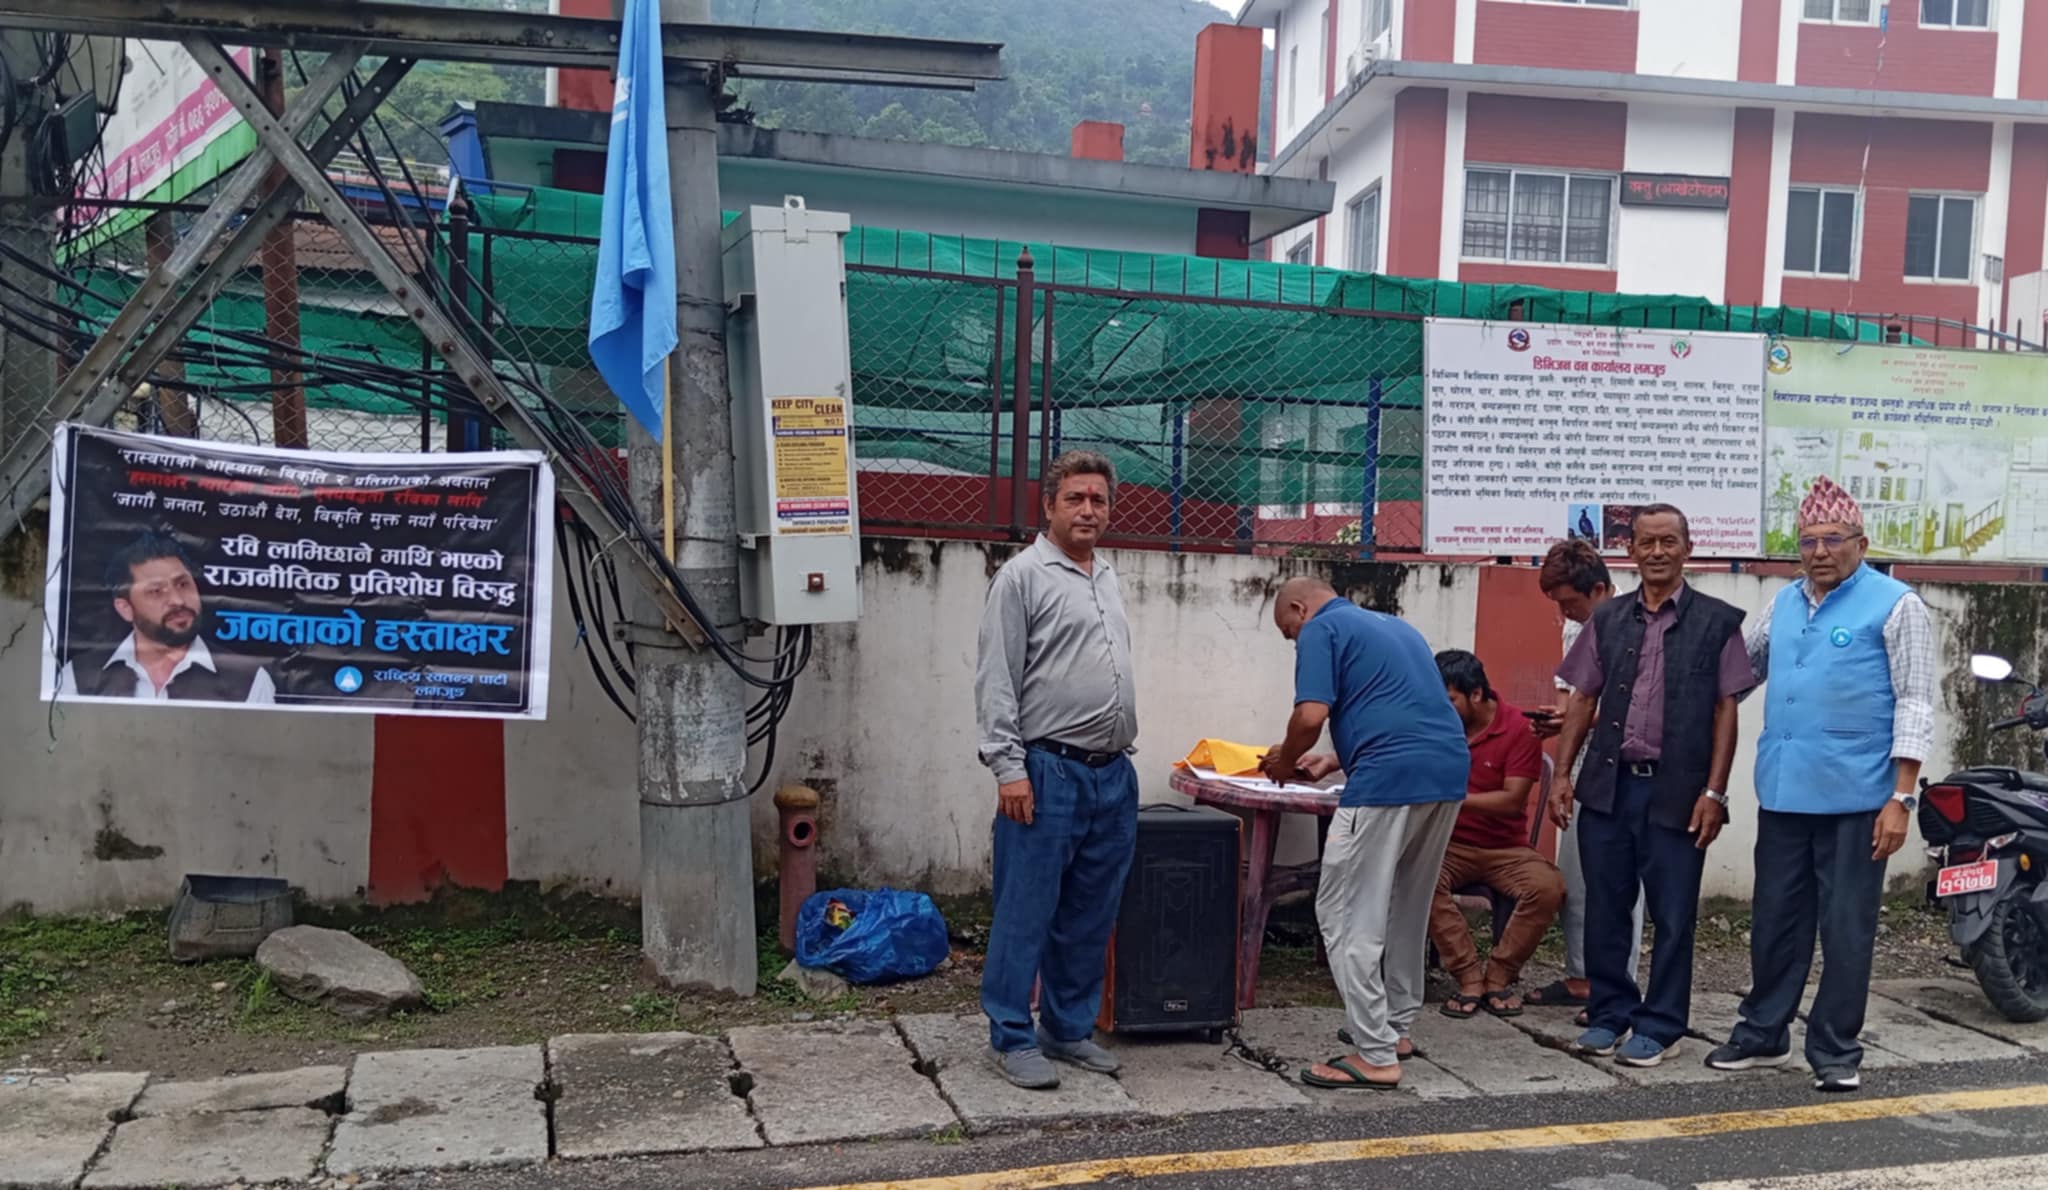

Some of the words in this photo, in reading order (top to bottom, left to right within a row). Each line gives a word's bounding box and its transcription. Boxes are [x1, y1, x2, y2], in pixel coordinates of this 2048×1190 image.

[1533, 355, 1571, 370] डिभिजन
[1574, 361, 1588, 371] वन
[1591, 359, 1631, 374] कार्यालय
[1634, 363, 1666, 377] लमजुङ
[772, 399, 793, 409] KEEP
[795, 399, 814, 409] CITY
[815, 404, 843, 414] CLEAN
[336, 474, 348, 485] र
[221, 534, 260, 557] रवि
[267, 538, 373, 563] लामिछाने
[381, 544, 434, 566] माथि
[441, 549, 504, 571] भएको
[204, 564, 341, 590] राजनीतिक
[350, 569, 444, 596] प्रतिशोध
[216, 609, 366, 647] जनताको
[374, 619, 514, 656] हस्ताक्षर
